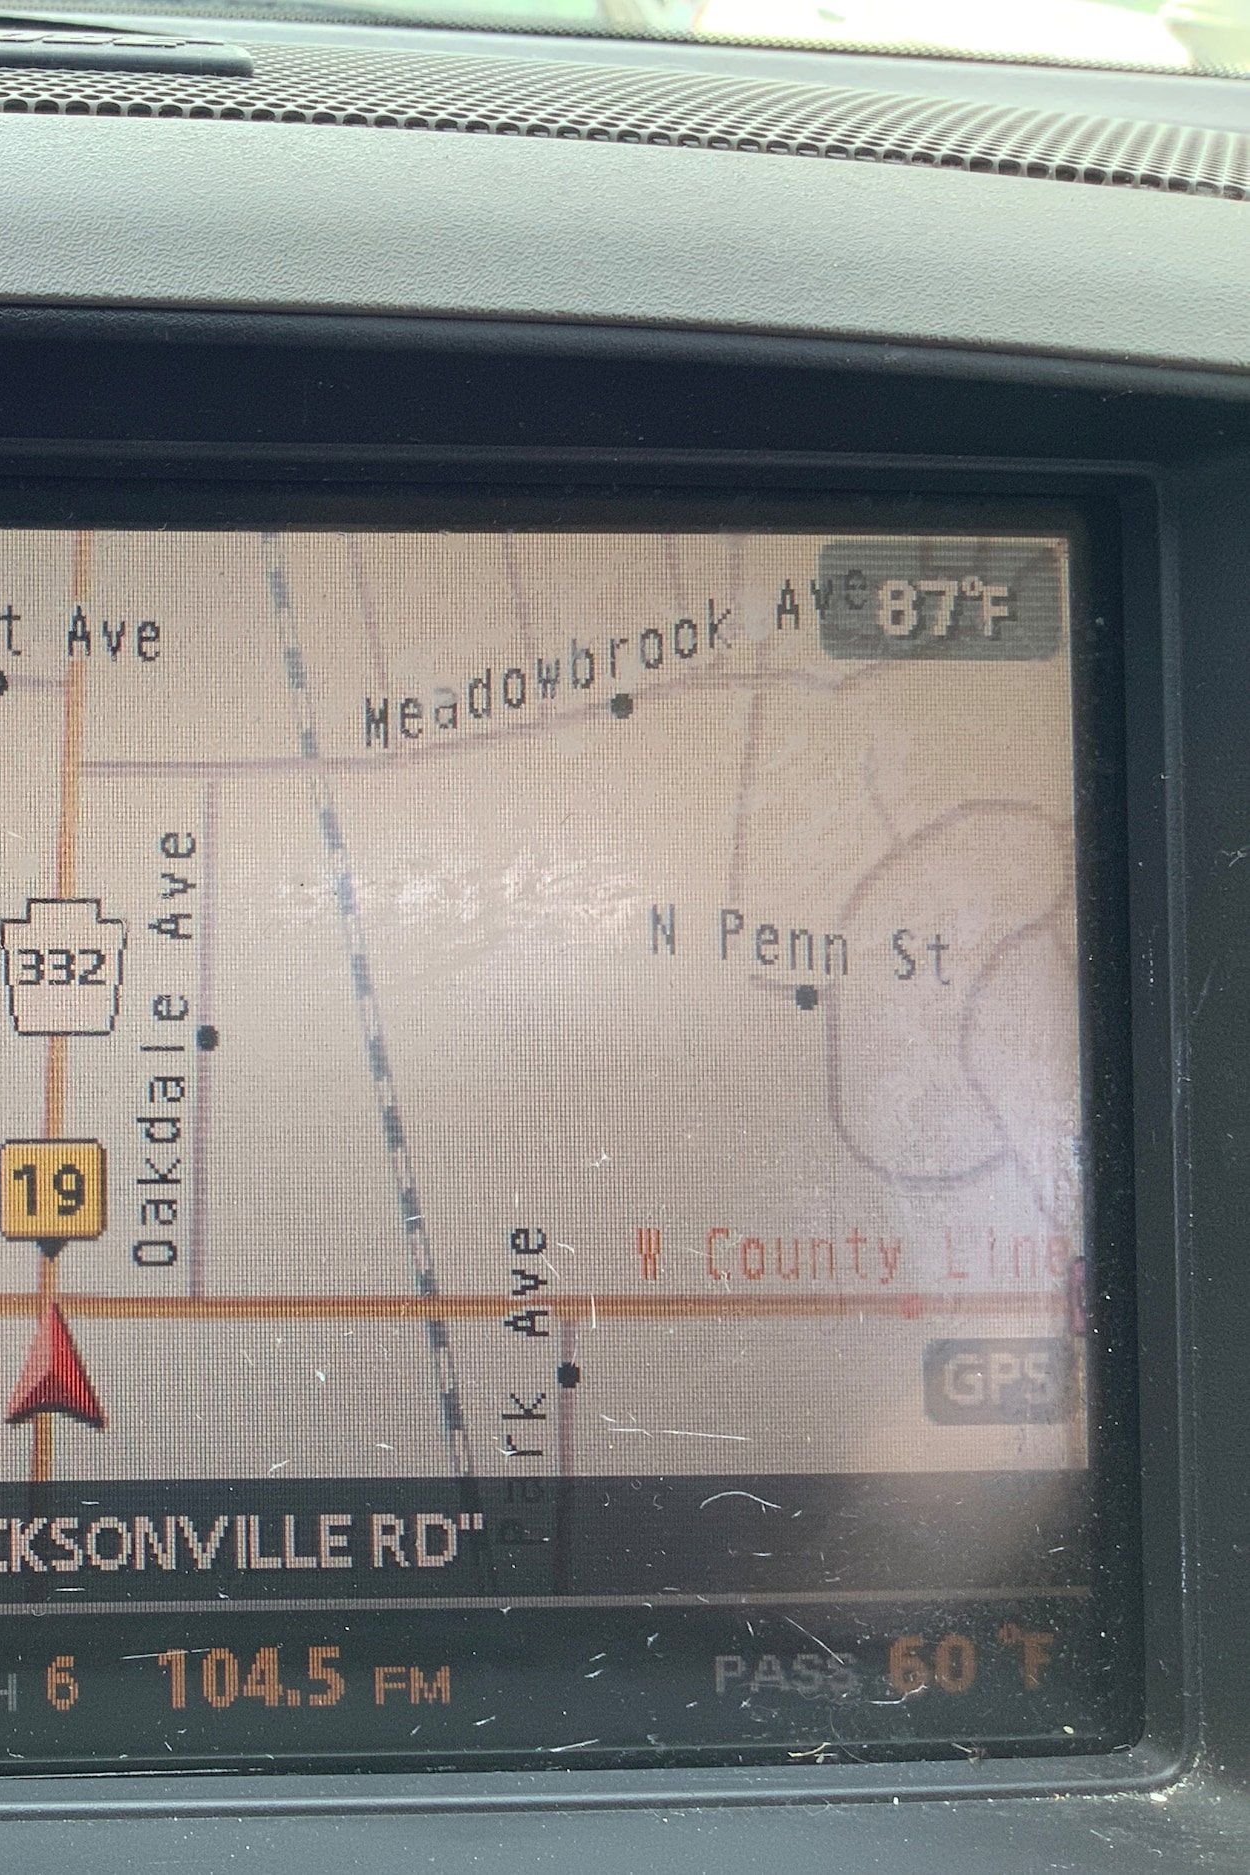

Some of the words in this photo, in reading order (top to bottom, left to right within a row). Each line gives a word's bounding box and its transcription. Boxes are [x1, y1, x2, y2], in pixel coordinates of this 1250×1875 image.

[67, 604, 161, 662] Ave
[363, 599, 734, 749] Meadowbrook
[775, 569, 868, 631] Ave
[148, 831, 197, 940] Ave
[16, 948, 108, 986] 332
[648, 903, 676, 956] N
[719, 908, 849, 976] Penn
[892, 928, 951, 986] St
[131, 993, 190, 1268] Oakdale
[13, 1162, 85, 1217] 19
[502, 1227, 549, 1338] Ave
[636, 1227, 662, 1281] W
[704, 1226, 903, 1286] County
[946, 1225, 1072, 1280] Line
[945, 1351, 1052, 1406] GPS
[372, 1512, 485, 1569] RD"
[47, 1655, 79, 1710] 6
[158, 1647, 346, 1709] 104.5
[374, 1665, 451, 1705] FM
[714, 1654, 858, 1695] PASS
